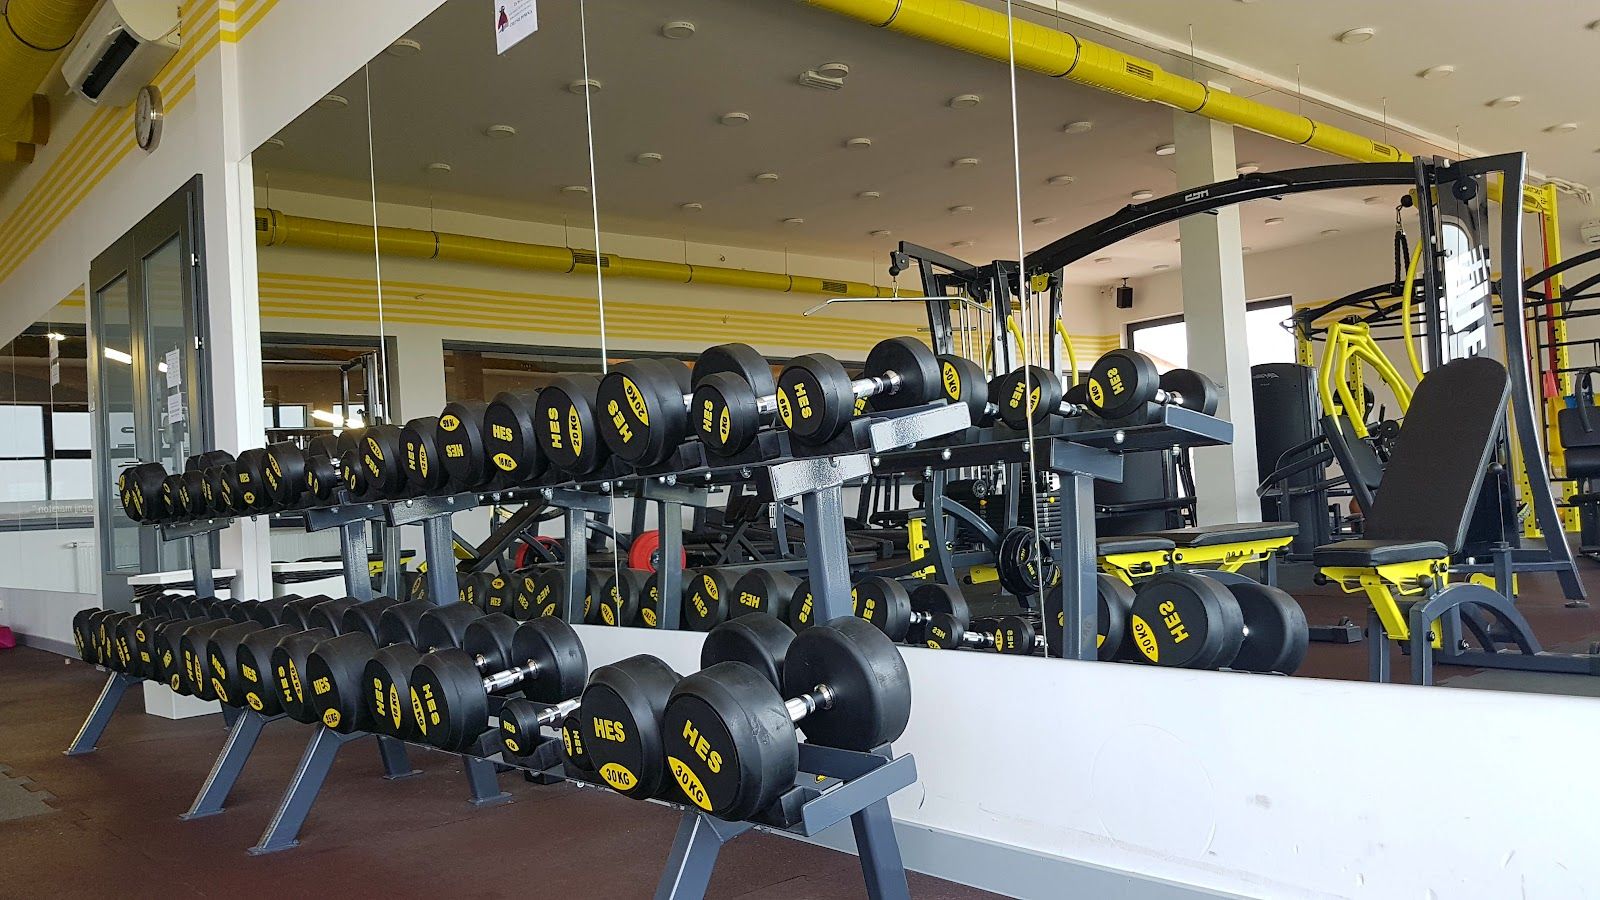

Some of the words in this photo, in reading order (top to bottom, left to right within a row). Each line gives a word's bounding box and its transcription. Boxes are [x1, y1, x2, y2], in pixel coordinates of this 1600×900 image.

[702, 399, 714, 433] HES
[793, 382, 812, 419] HES
[492, 424, 513, 442] HES
[547, 407, 563, 449] HES
[607, 399, 633, 444] HES
[406, 442, 416, 471] HES
[445, 443, 465, 458] HES
[277, 665, 293, 702] HES
[313, 676, 331, 695] HES
[373, 677, 386, 717] HES
[422, 683, 441, 726] HES
[504, 719, 516, 734] HES
[572, 730, 583, 755] HES
[593, 716, 627, 743] HES
[682, 719, 723, 774] HES
